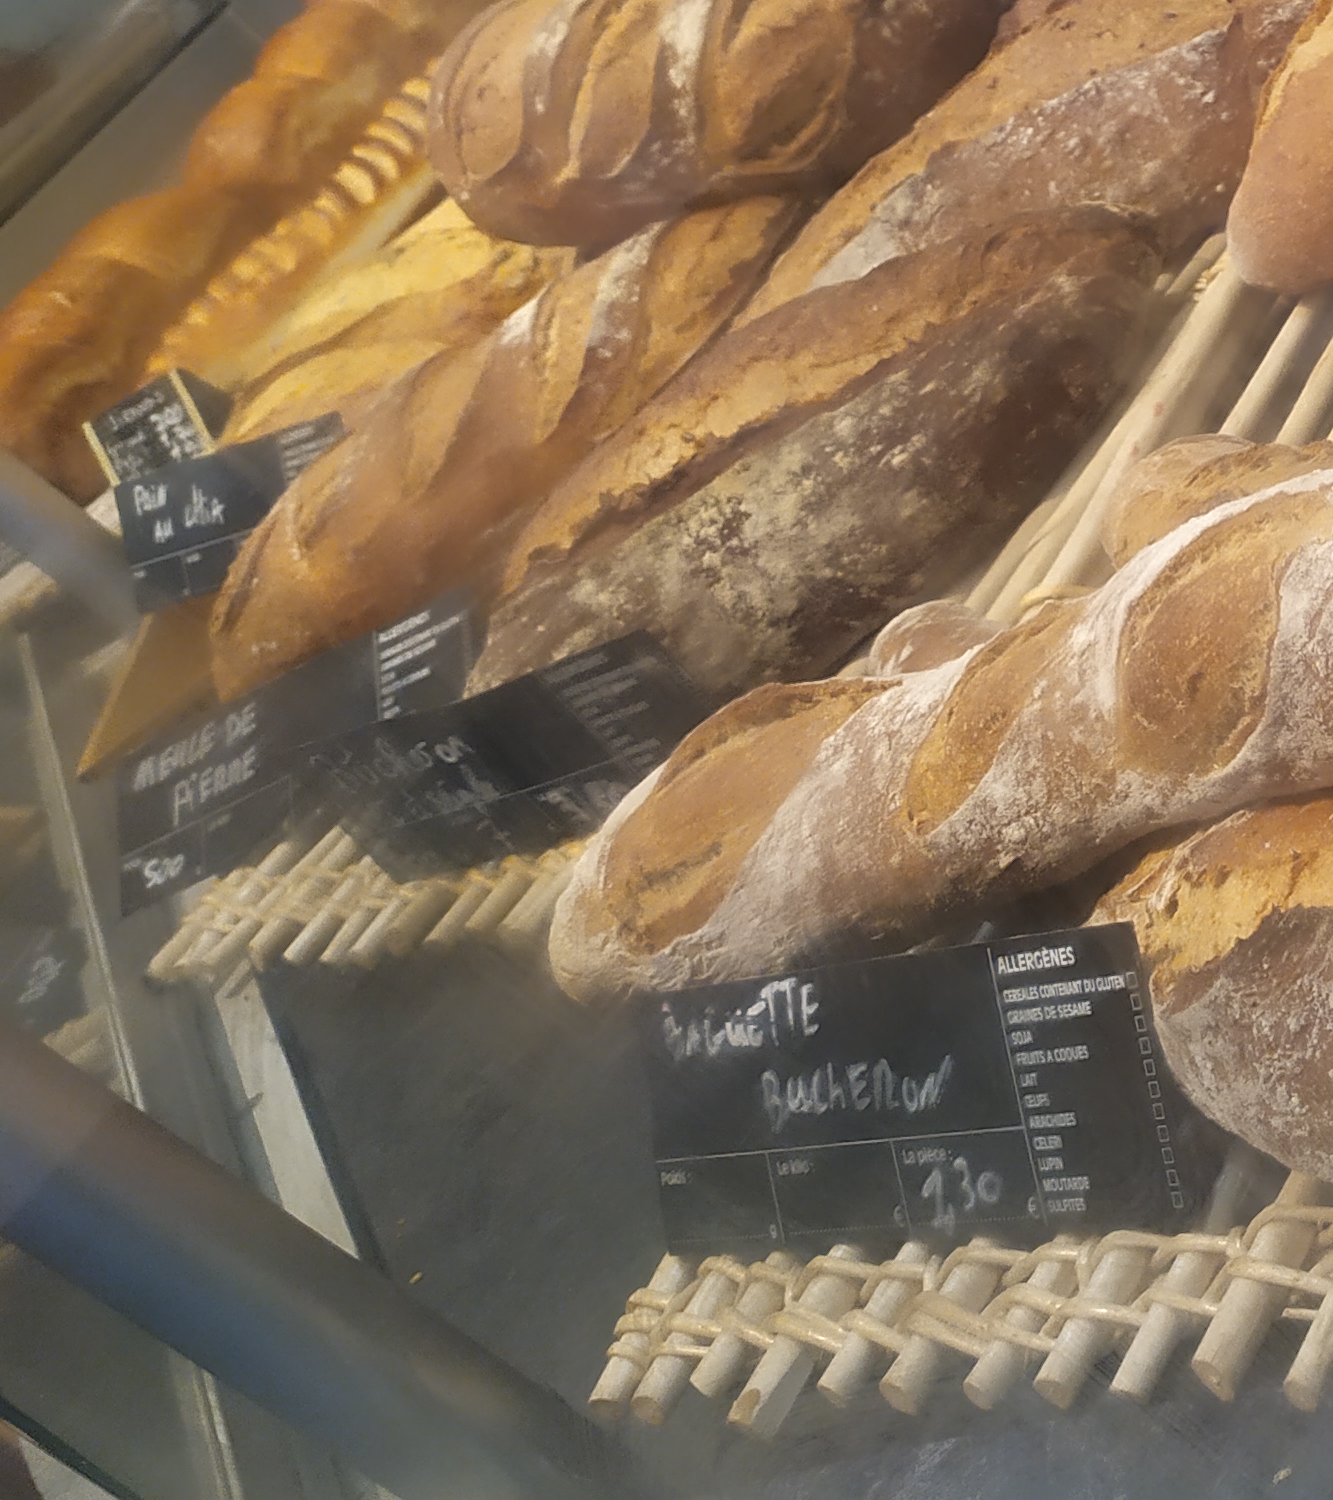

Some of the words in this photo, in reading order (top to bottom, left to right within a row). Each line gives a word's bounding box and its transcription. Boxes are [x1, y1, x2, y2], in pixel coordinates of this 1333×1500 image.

[998, 946, 1075, 974] ALLERGÈNES
[1011, 1030, 1033, 1045] SOJA
[1016, 1049, 1045, 1065] FRUITS
[1054, 1046, 1089, 1061] COQUES
[1020, 1072, 1038, 1086] LAIT
